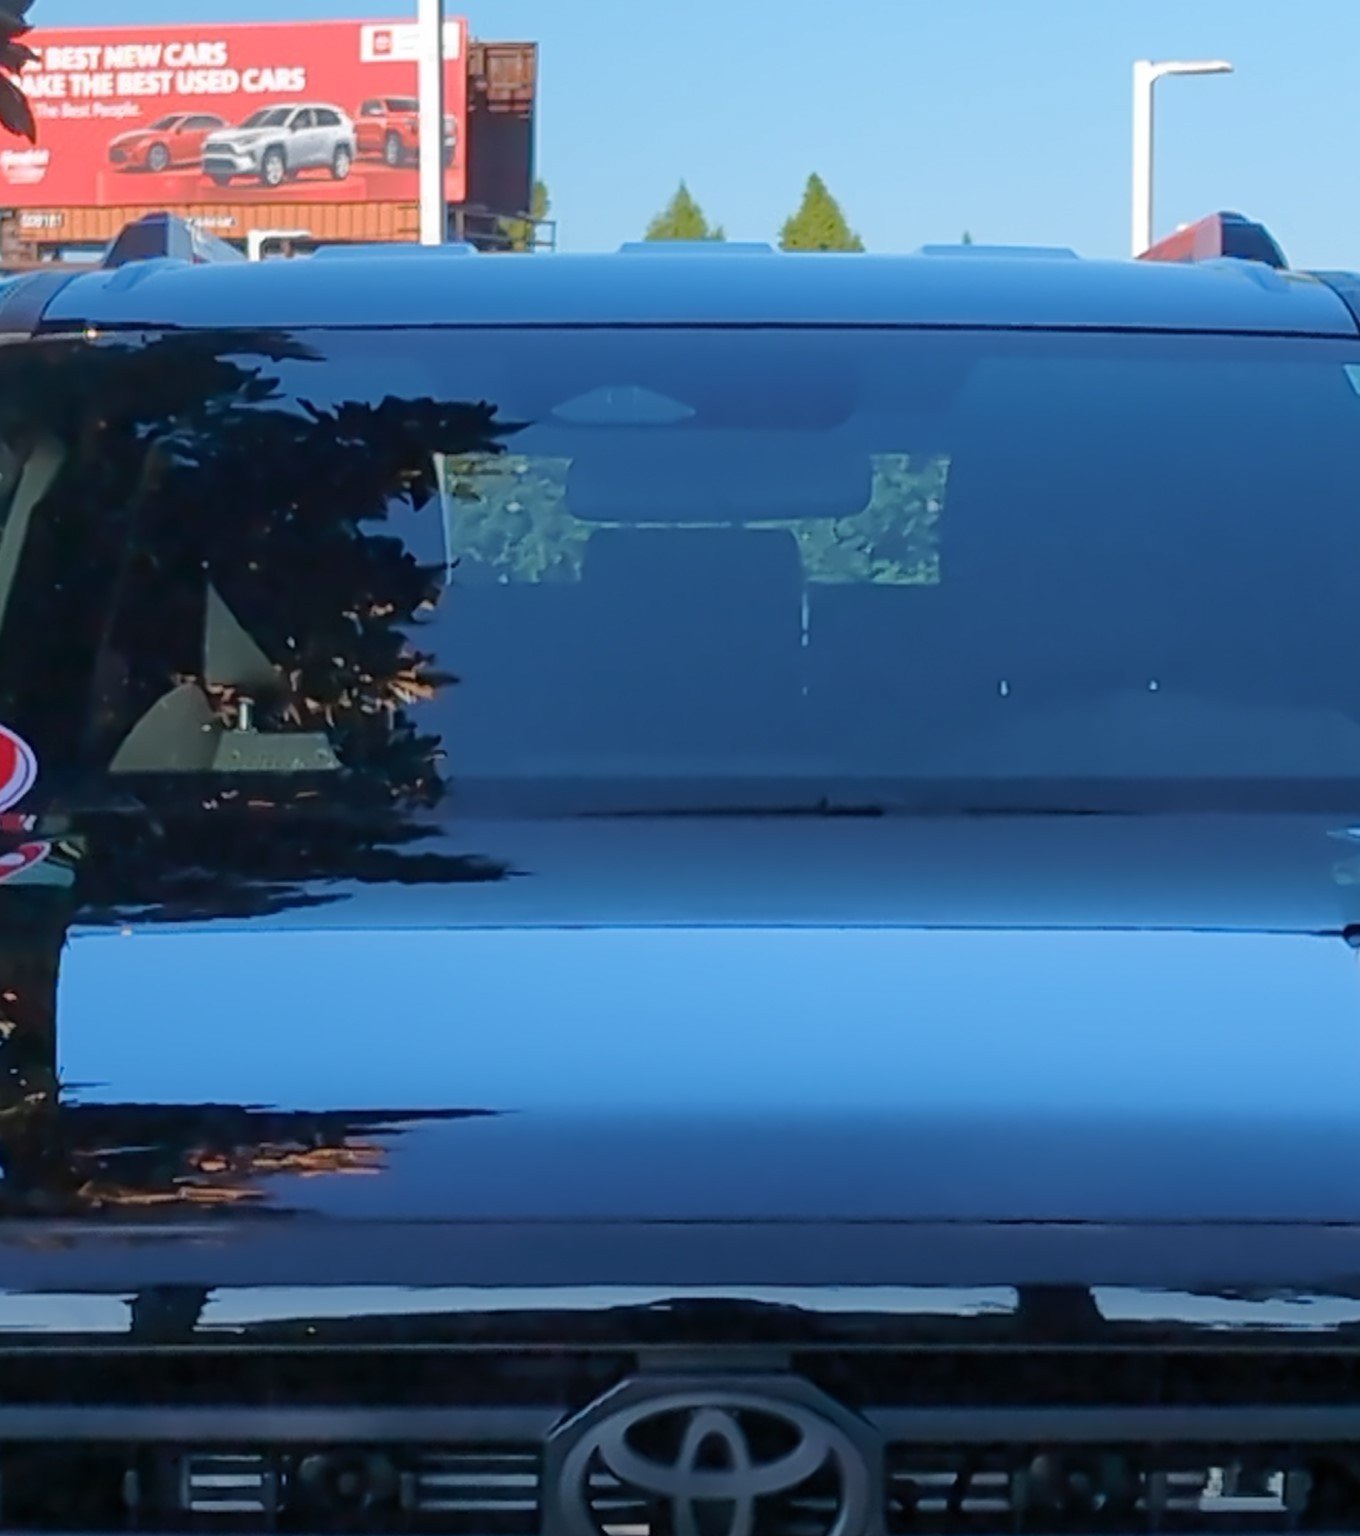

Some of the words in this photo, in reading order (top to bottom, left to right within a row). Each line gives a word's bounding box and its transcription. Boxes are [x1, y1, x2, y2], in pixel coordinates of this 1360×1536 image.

[45, 45, 102, 70] BEST
[104, 43, 162, 69] NEW
[163, 41, 228, 67] CARS
[69, 71, 114, 96] THE
[116, 70, 174, 95] BEST
[175, 69, 240, 94] USED
[241, 67, 307, 93] CARS
